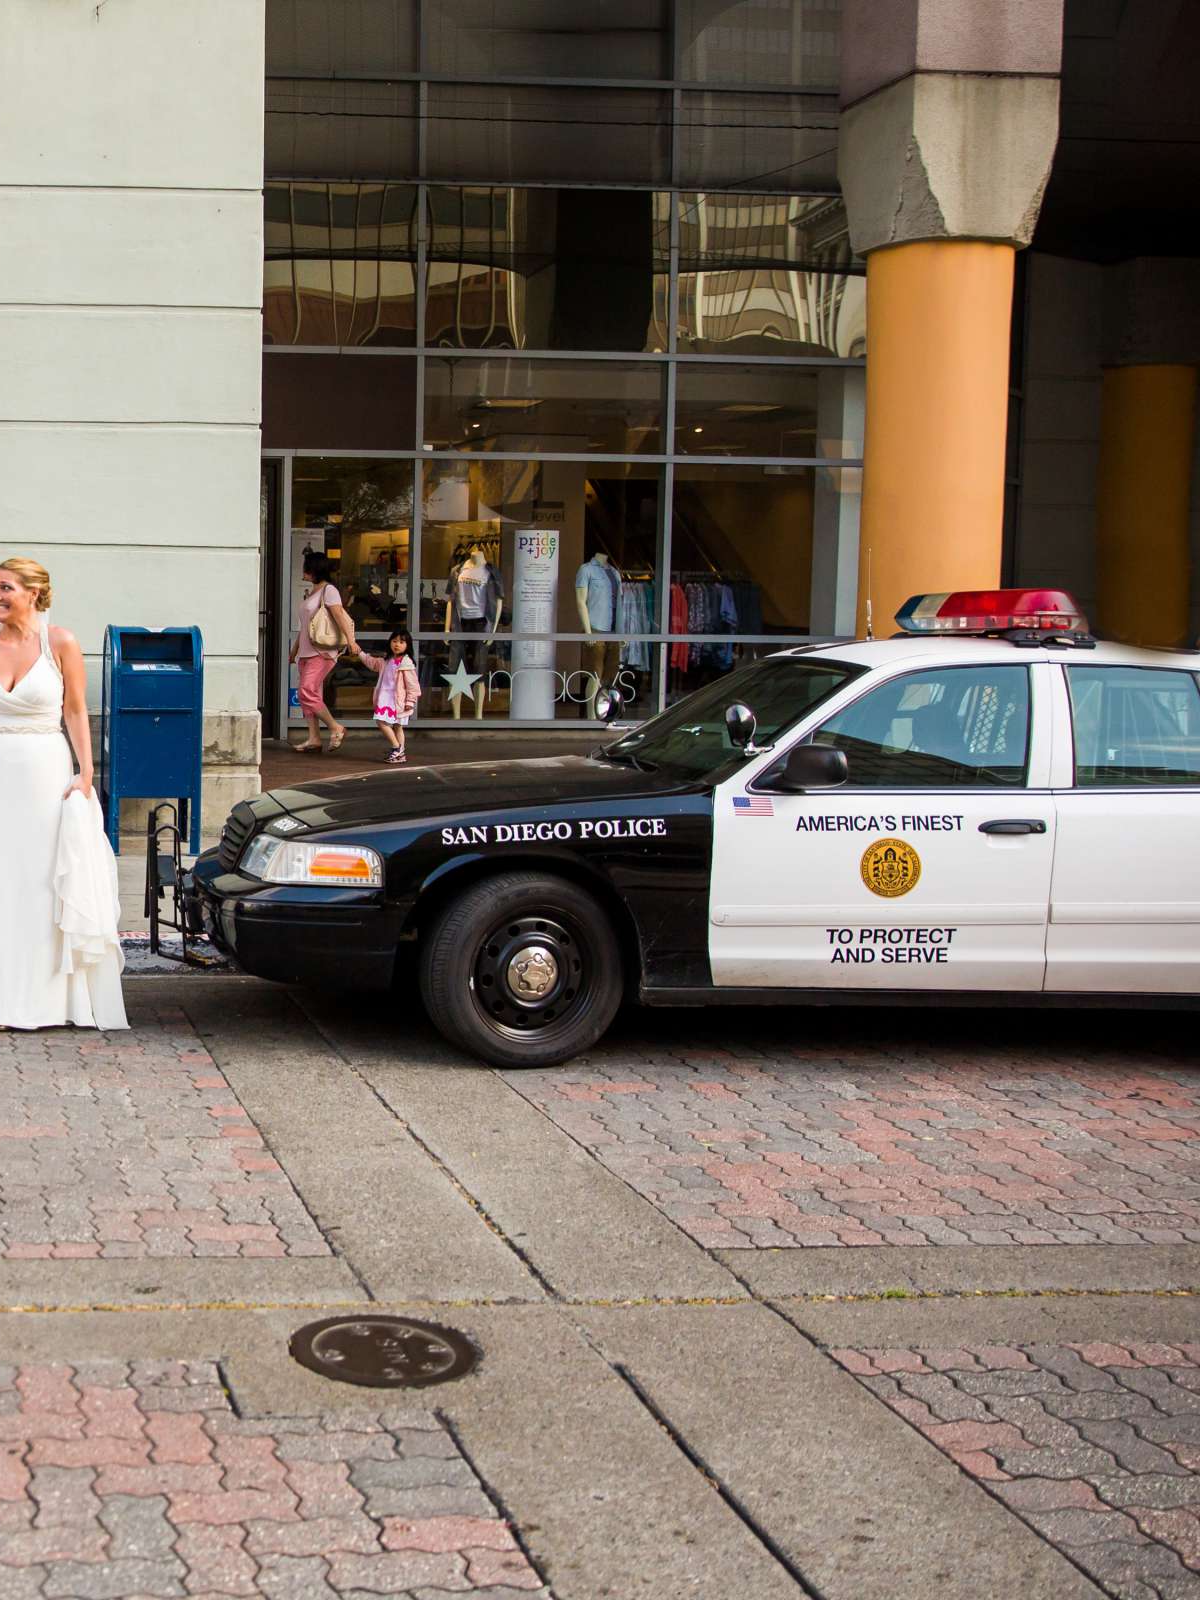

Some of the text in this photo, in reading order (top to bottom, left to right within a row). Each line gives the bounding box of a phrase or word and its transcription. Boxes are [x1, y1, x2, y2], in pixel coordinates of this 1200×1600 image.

[518, 532, 556, 550] pride
[796, 815, 964, 831] AMERICA'S FINEST
[441, 818, 667, 846] SAN DIEGO POLICE
[826, 928, 957, 944] TO PROTECT
[830, 947, 948, 964] AND SERVE
